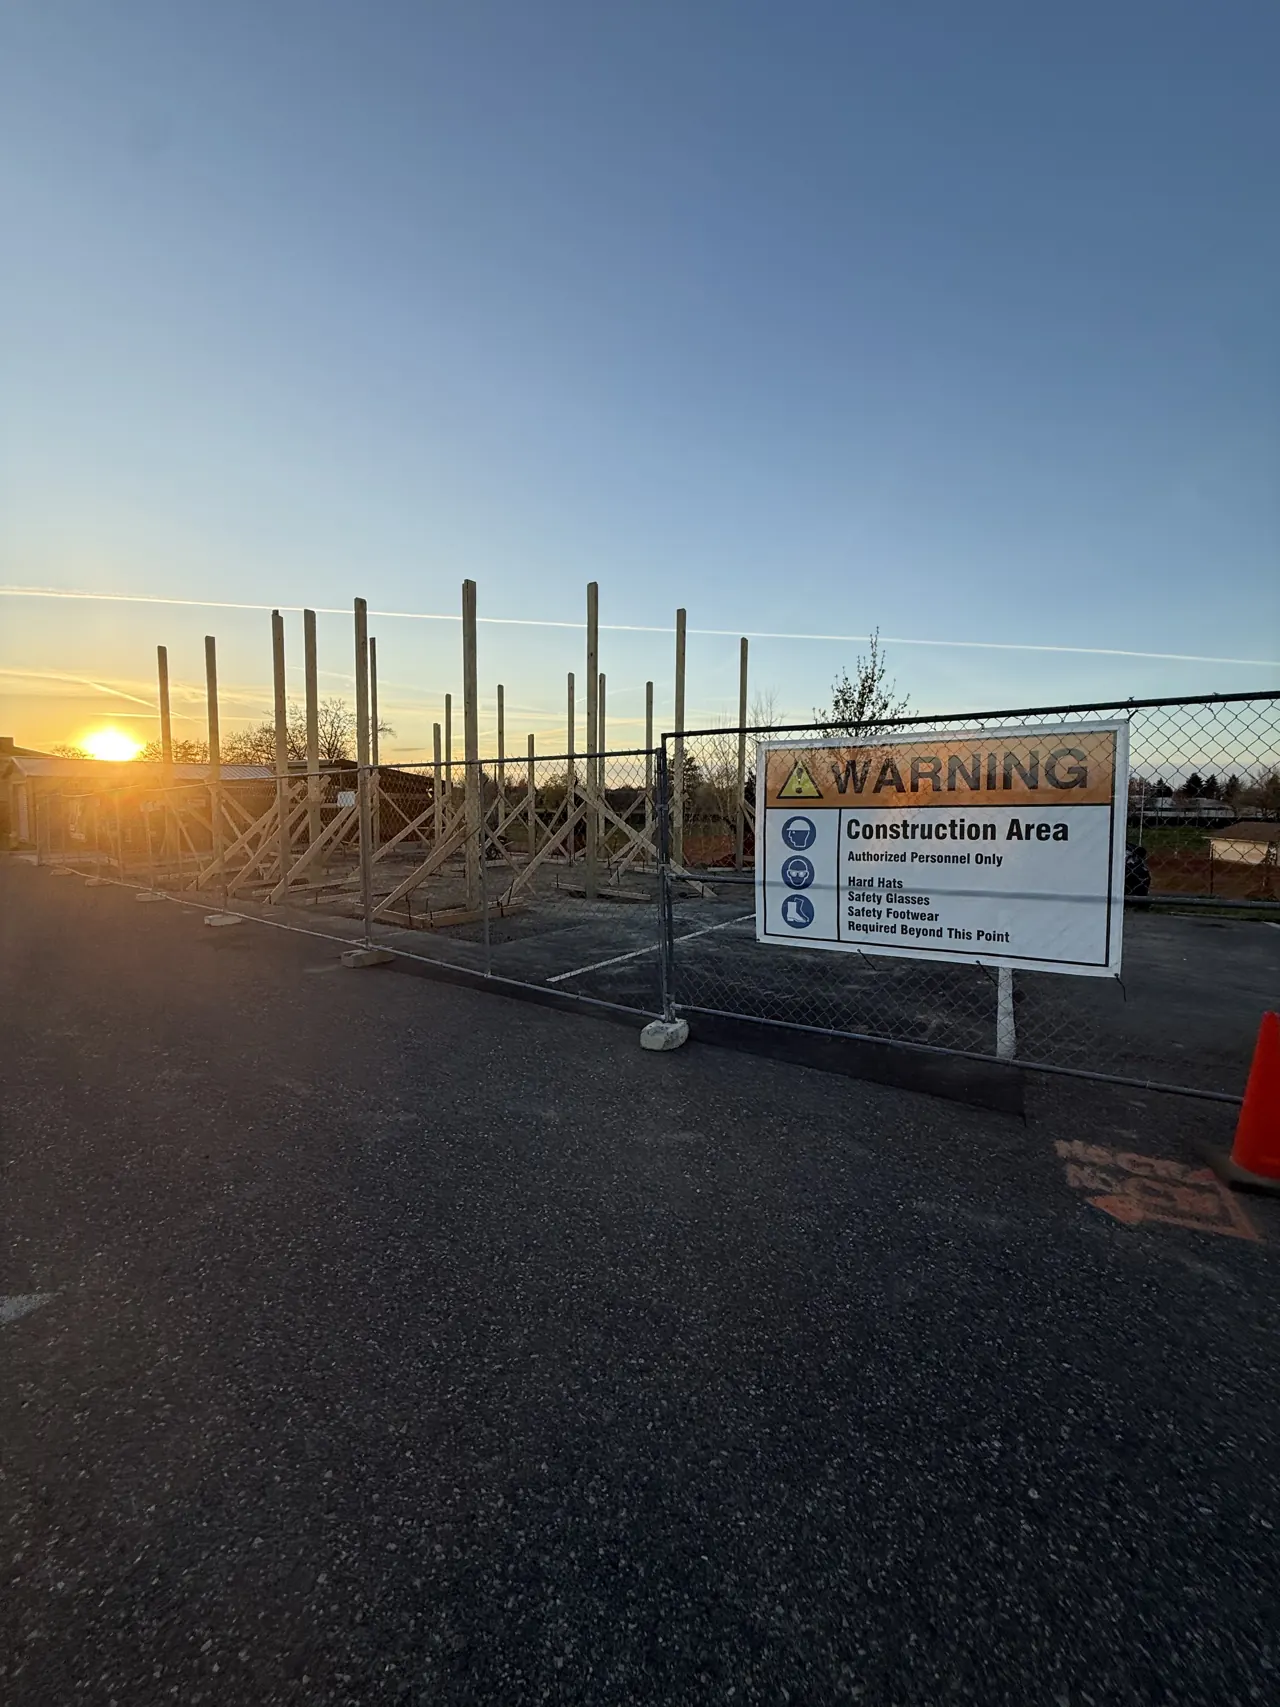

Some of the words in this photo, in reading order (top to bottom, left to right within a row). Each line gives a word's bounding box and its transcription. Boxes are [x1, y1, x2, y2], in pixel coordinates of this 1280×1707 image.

[832, 749, 1088, 794] WARNING
[846, 818, 997, 841] Construction
[1006, 818, 1069, 842] Area
[847, 850, 907, 863] Authorized
[910, 852, 971, 865] Personnel
[974, 853, 1004, 867] Only
[847, 876, 874, 888] Hard
[877, 877, 904, 889] Hats
[847, 891, 883, 904] Safety
[885, 893, 931, 906] Glasses
[847, 906, 883, 919] Safety
[886, 908, 940, 922] Footwear
[847, 921, 897, 934] Required
[900, 923, 944, 938] Beyond
[947, 927, 973, 941] This
[976, 930, 1010, 943] Point
